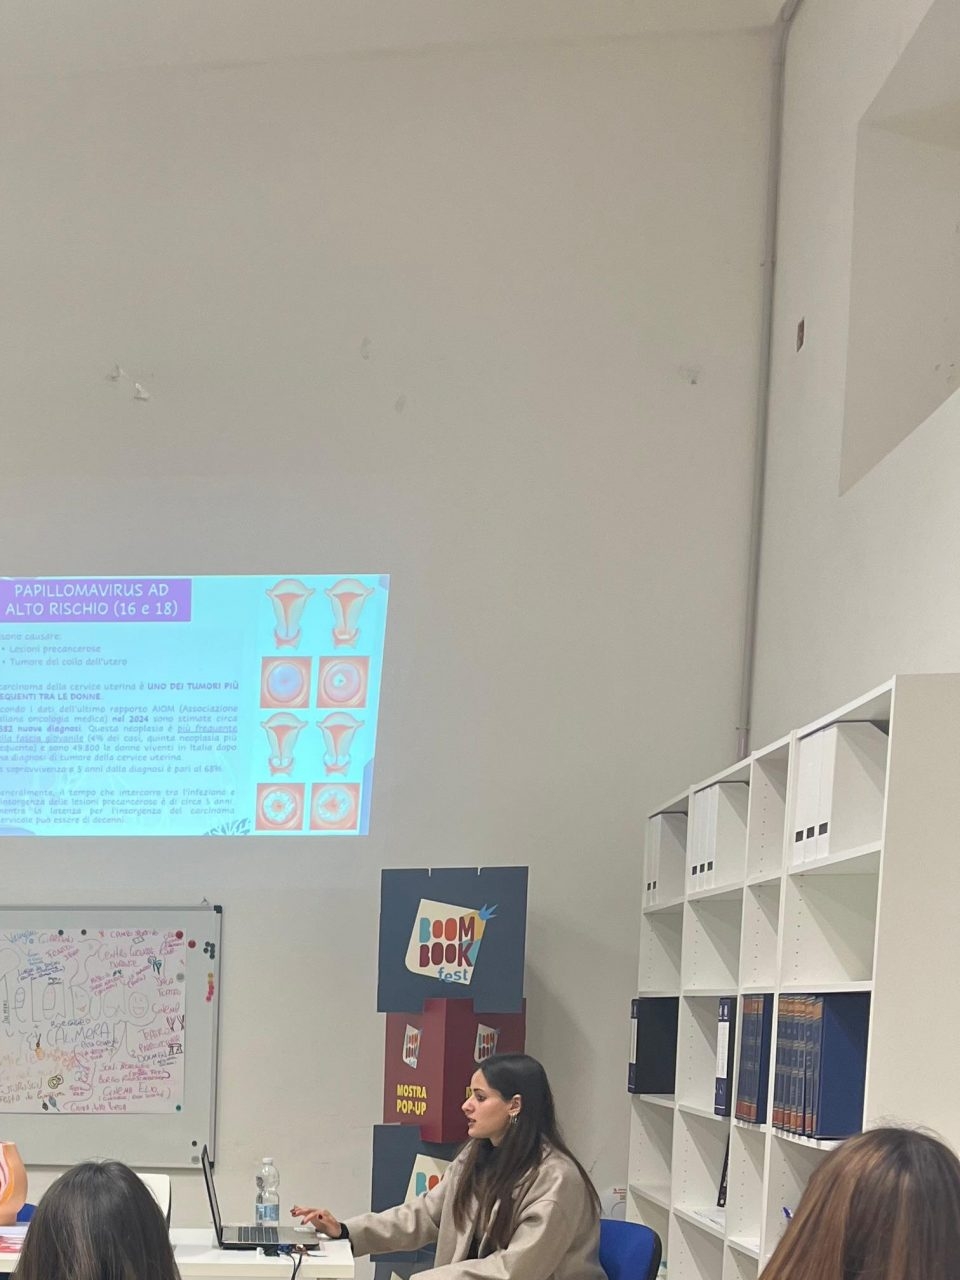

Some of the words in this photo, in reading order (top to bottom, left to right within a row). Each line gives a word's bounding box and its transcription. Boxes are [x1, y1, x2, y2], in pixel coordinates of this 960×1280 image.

[15, 584, 143, 597] PAPILLOMAVIRUS
[148, 583, 168, 596] AD
[5, 602, 44, 616] ALTO
[49, 602, 108, 615] RISCHIO
[113, 600, 136, 617] (16
[142, 604, 149, 615] e
[155, 600, 178, 617] 18)
[43, 646, 101, 654] precancerose
[224, 680, 239, 690] PIÙ
[39, 693, 55, 701] TRA
[57, 693, 68, 701] LE
[110, 706, 148, 714] rapporto
[419, 916, 475, 943] BOOM
[419, 942, 474, 968] BOOK
[437, 966, 469, 983] fest
[397, 1084, 427, 1099] MOSTRA
[396, 1099, 427, 1116] POP-UP
